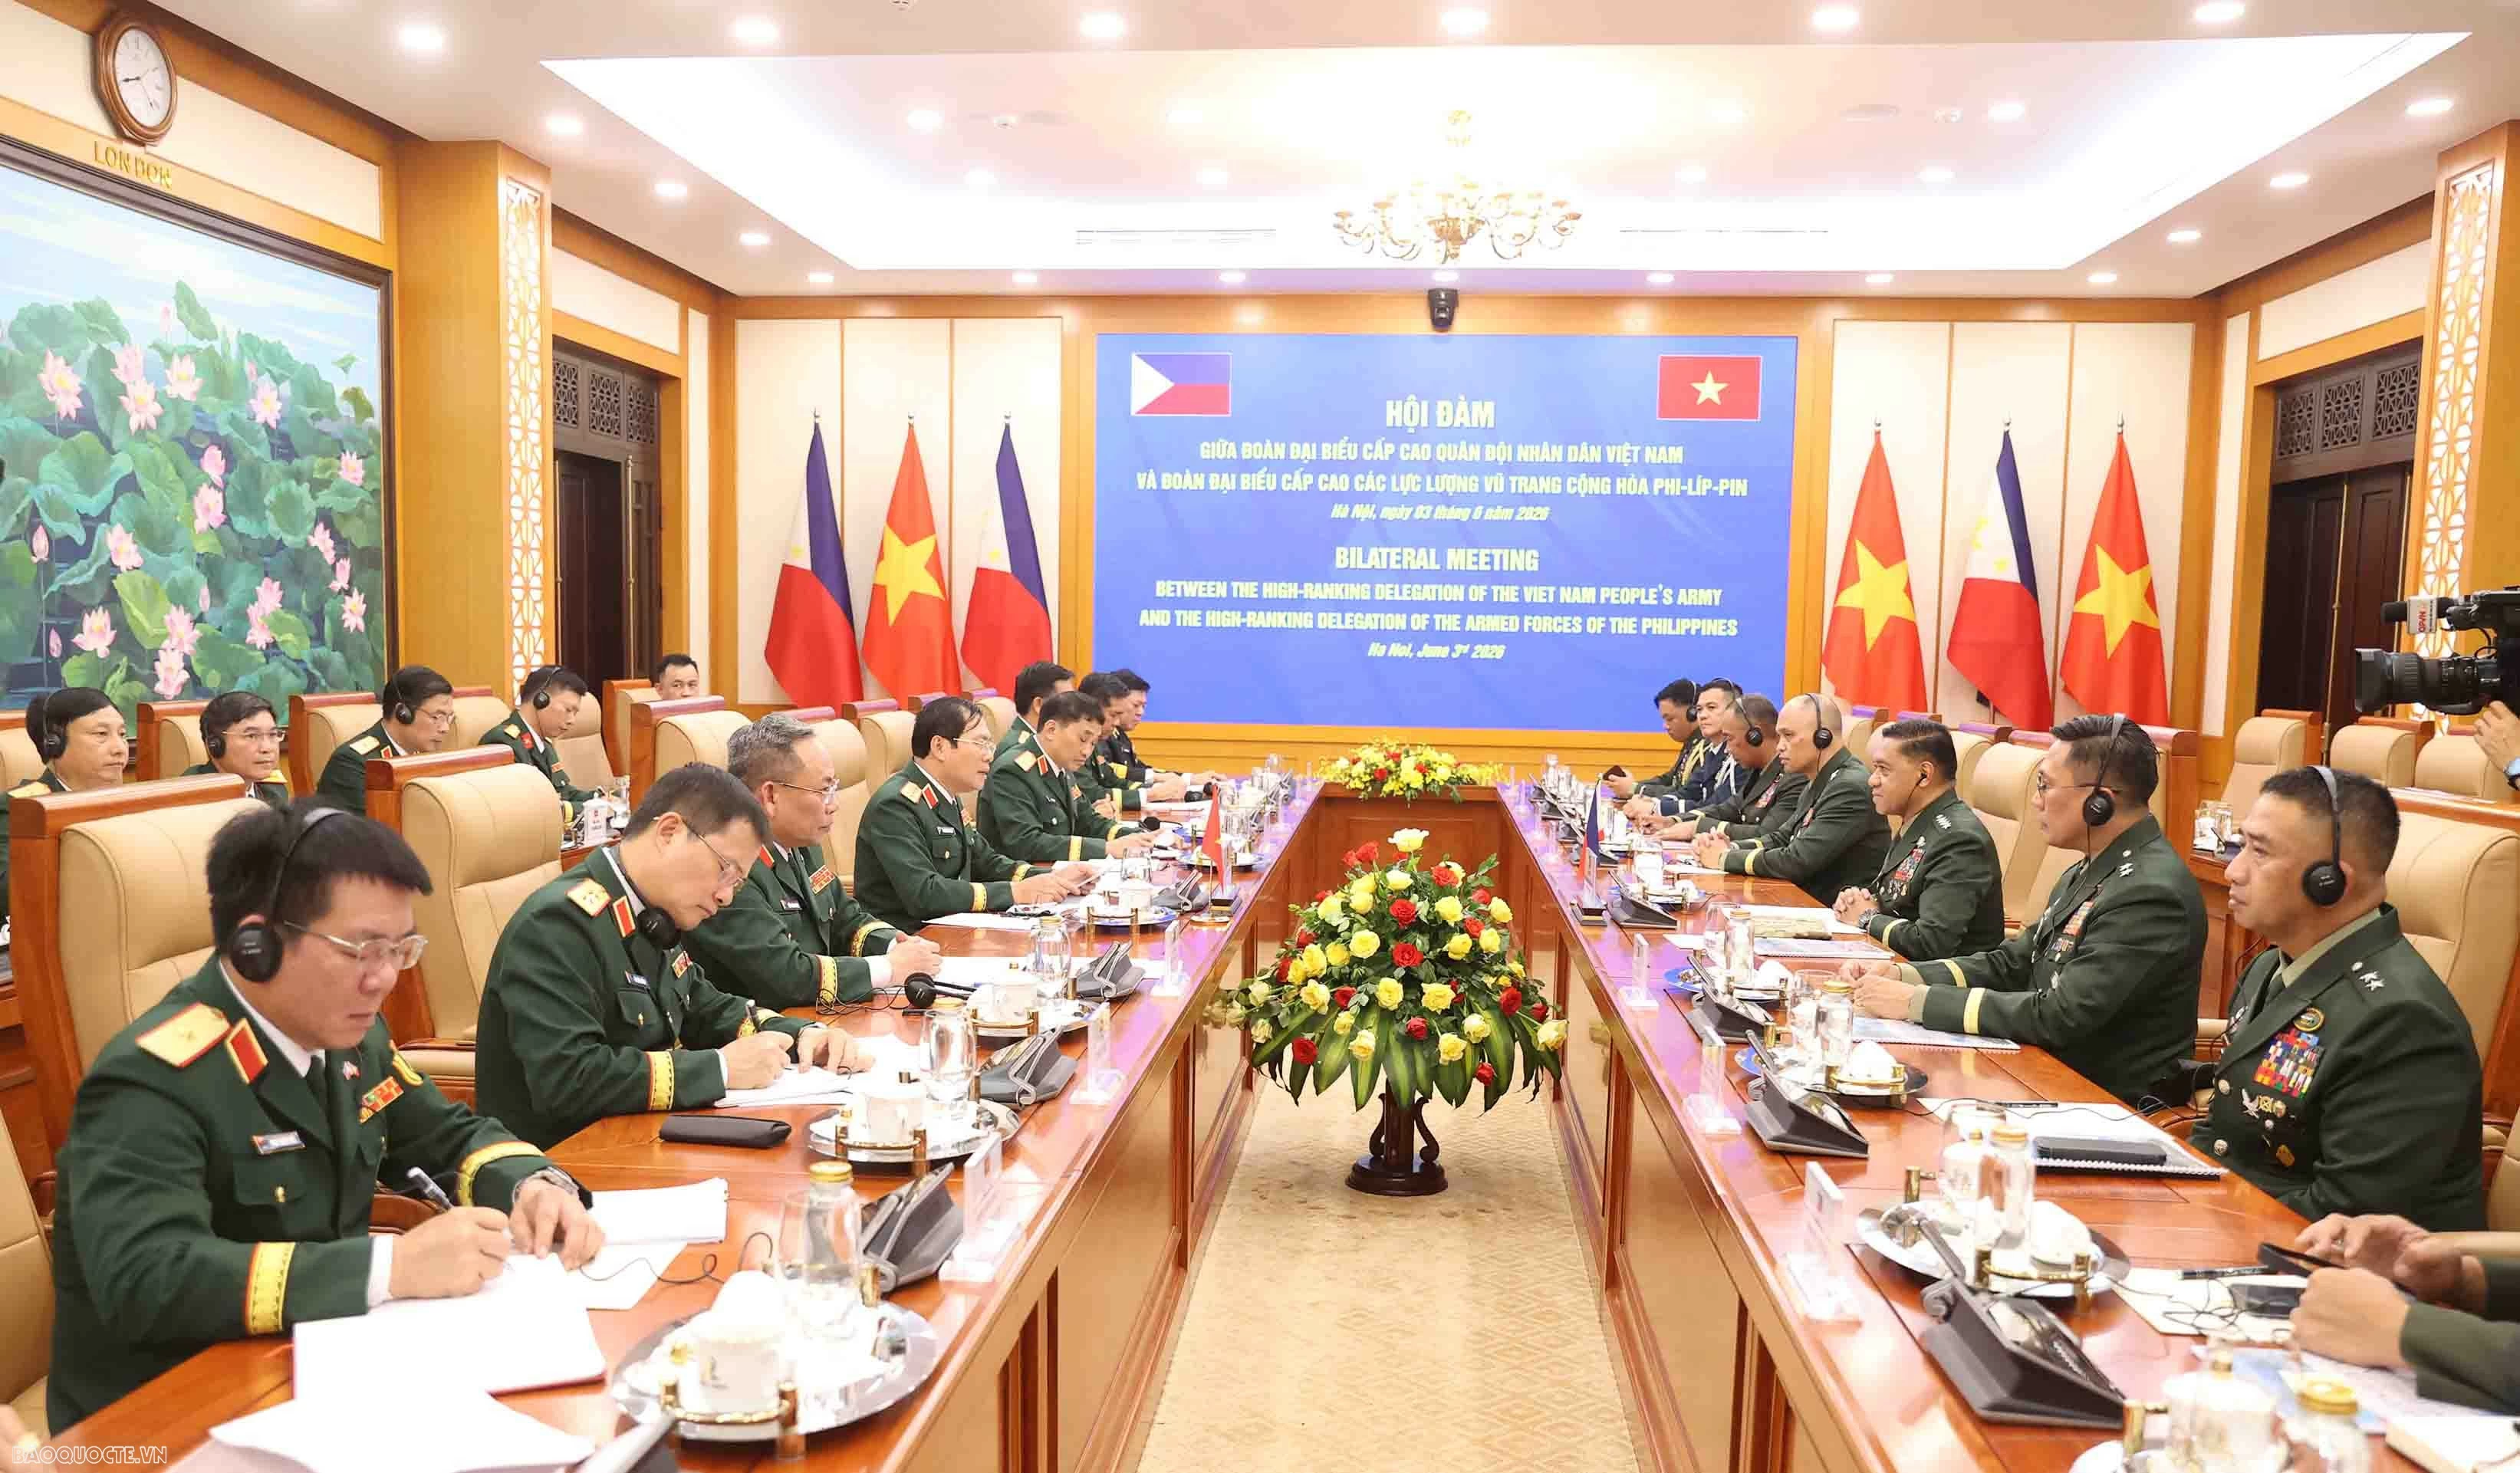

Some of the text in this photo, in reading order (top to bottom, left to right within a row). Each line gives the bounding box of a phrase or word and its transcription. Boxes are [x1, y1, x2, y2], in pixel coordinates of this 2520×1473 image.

[94, 140, 173, 189] LONDON
[1386, 394, 1495, 433] HỘI ĐÀM
[1199, 437, 1683, 467] GIỮA ĐOÀN ĐẠI BIỂU CẤP CAO QUÂN ĐỘI NHÂN DÂN VIỆT NAM
[1137, 468, 1749, 498] VÀ ĐOÀN ĐẠI BIỂU CẤP CAO CÁC LỰC LƯỢNG VŨ TRANG CỘNG HÒA PHI-LÍP-PIN
[1334, 546, 1540, 571] BILATERAL MEETING
[1155, 580, 1228, 598] BETWEEN
[1230, 580, 1258, 598] THE
[1262, 581, 1371, 600] HIGH-RANKING
[1374, 584, 1466, 602] DELEGATION
[1468, 584, 1488, 602] OF
[1490, 585, 1521, 603] THE
[1522, 585, 1557, 603] VIET
[1559, 586, 1597, 604] NAM
[1676, 588, 1723, 607] ARMY
[1139, 609, 1739, 636] AND THE HIGH-RANKING DELEGATION OF THE ARMED FORCES OF THE PHILIPPINES
